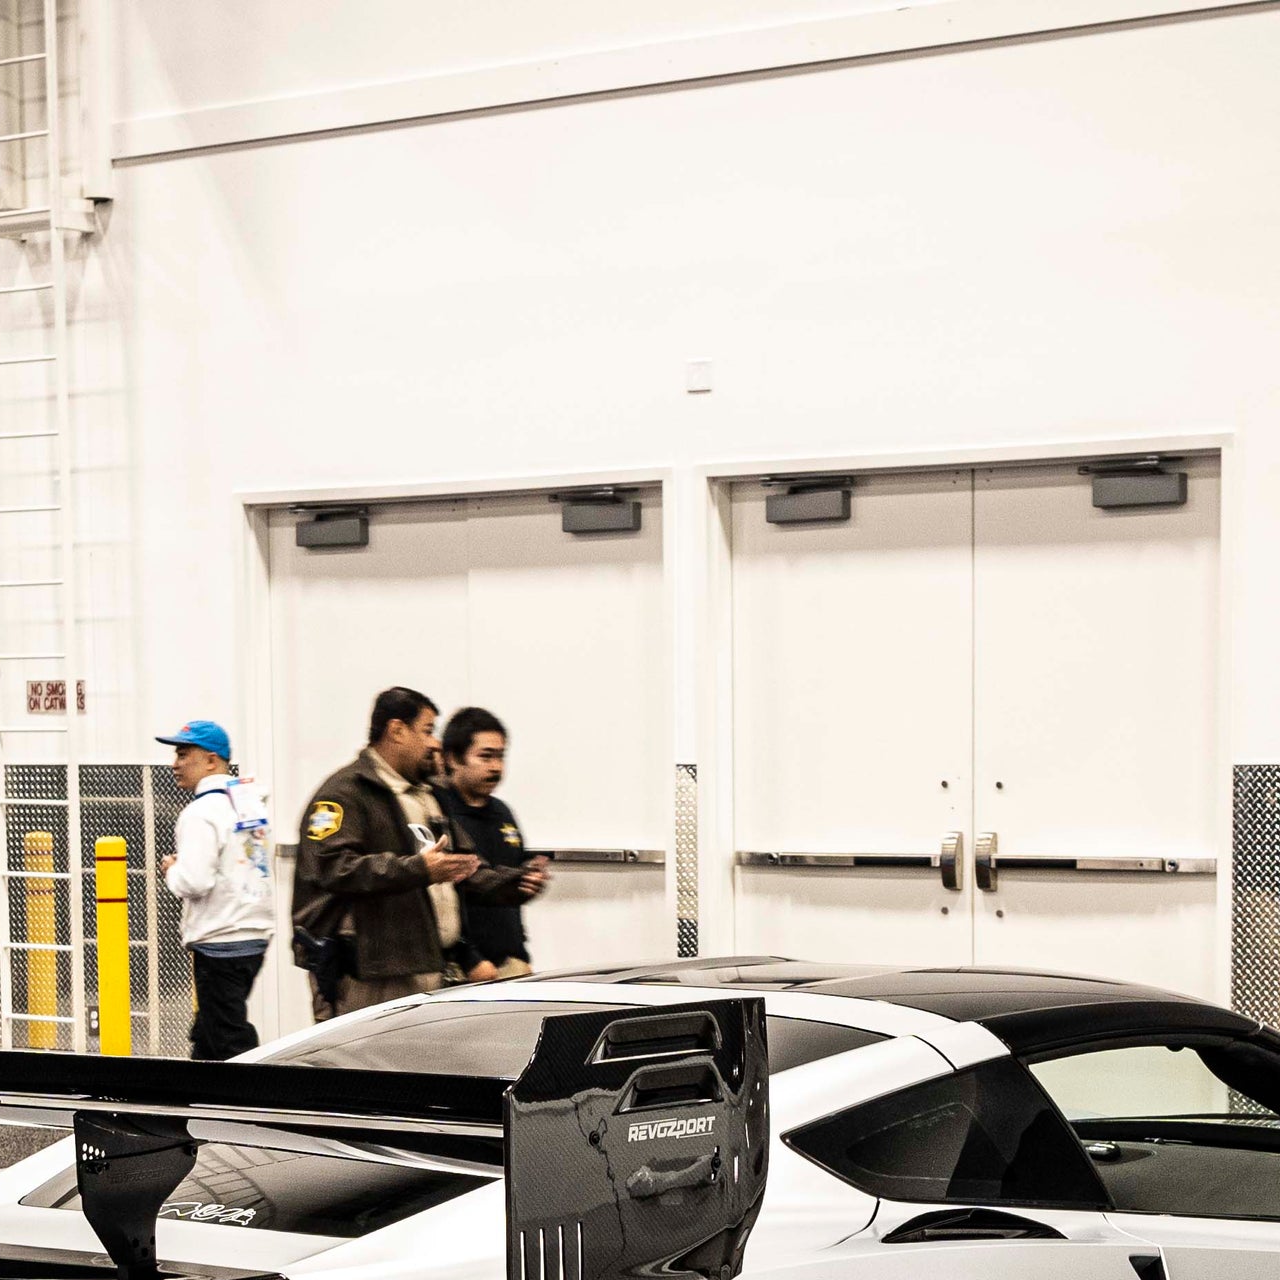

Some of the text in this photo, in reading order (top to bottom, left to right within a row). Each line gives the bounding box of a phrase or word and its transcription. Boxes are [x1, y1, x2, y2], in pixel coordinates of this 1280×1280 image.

[30, 682, 83, 696] NO SMOG
[29, 698, 40, 710] ON
